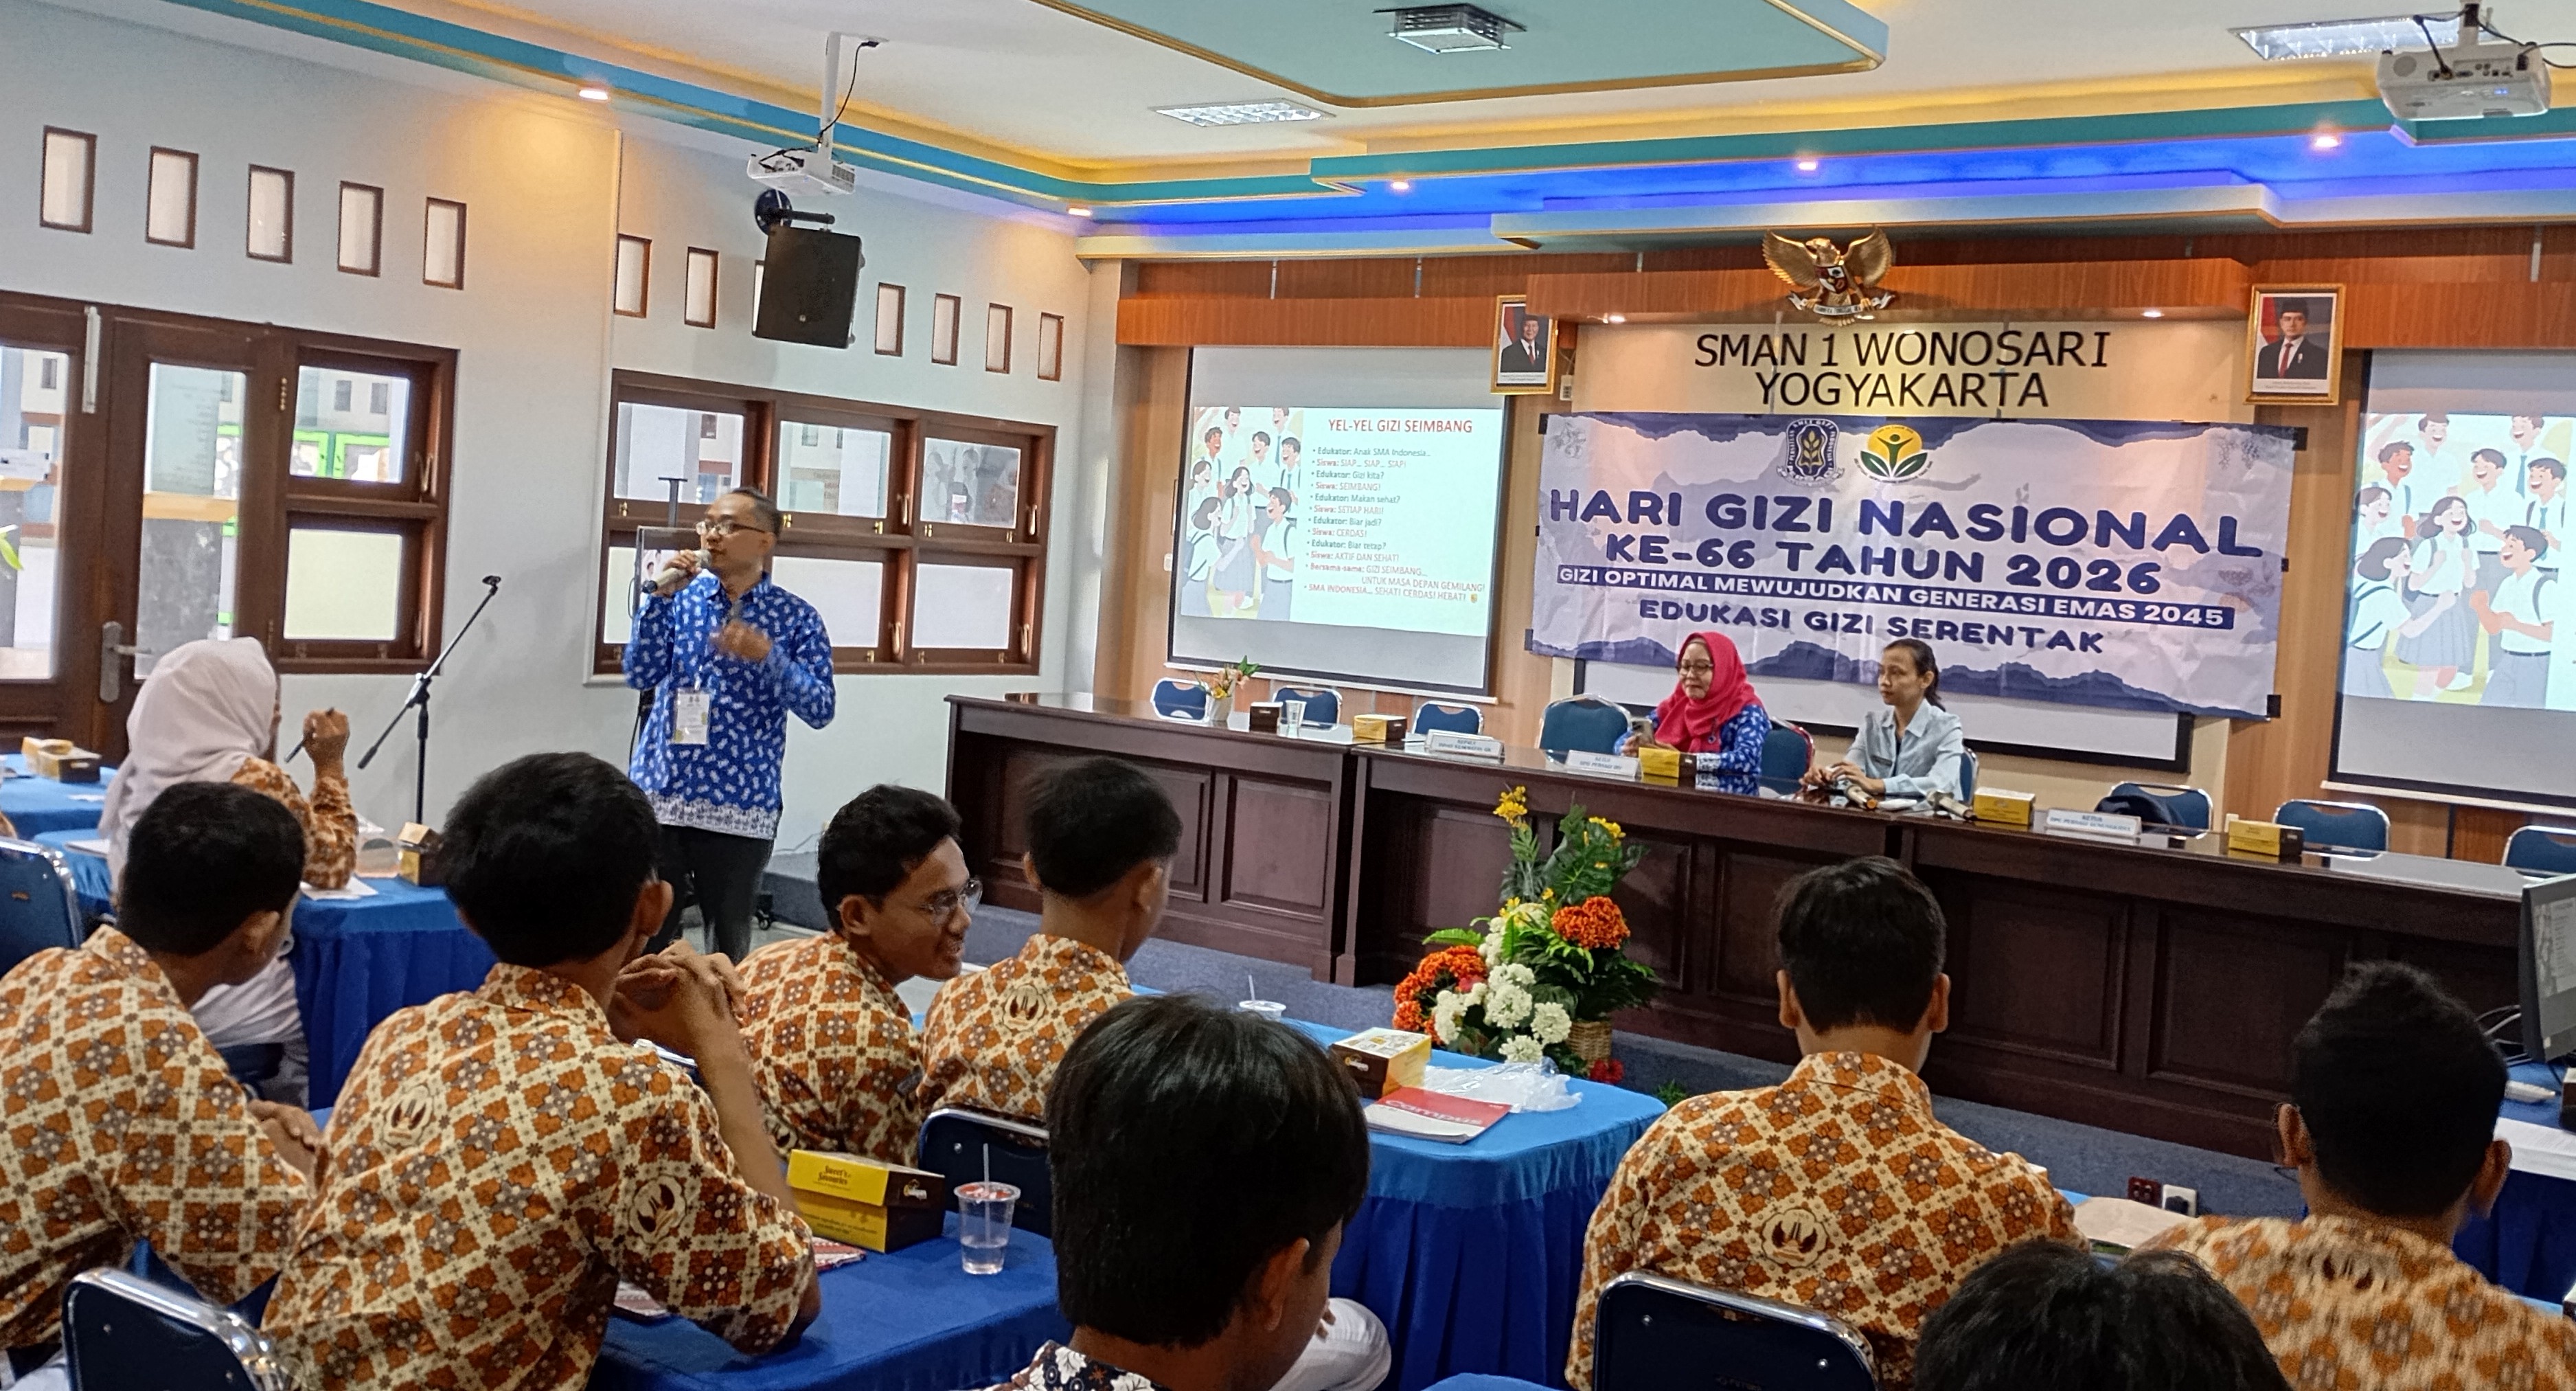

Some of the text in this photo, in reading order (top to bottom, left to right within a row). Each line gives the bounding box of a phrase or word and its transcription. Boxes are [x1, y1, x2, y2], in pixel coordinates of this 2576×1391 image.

[1695, 330, 2111, 367] SMAN 1 WONOSARI
[1755, 372, 2049, 407] YOGYAKARTA
[1329, 419, 1472, 433] YEL-YEL GIZI SEIMBANG
[1551, 489, 2263, 557] HARI GIZI NASIONAL
[1356, 553, 1372, 561] DAN
[1606, 534, 2161, 594] KE-66 TAHUN 2026
[1560, 567, 2223, 625] GIZI OPTIMAL MEWUJUDKAN GENERASI EMAS 2045
[1639, 599, 2104, 653] EDUKASI GIZI SERENTAK
[1385, 1100, 1483, 1124] Campus
